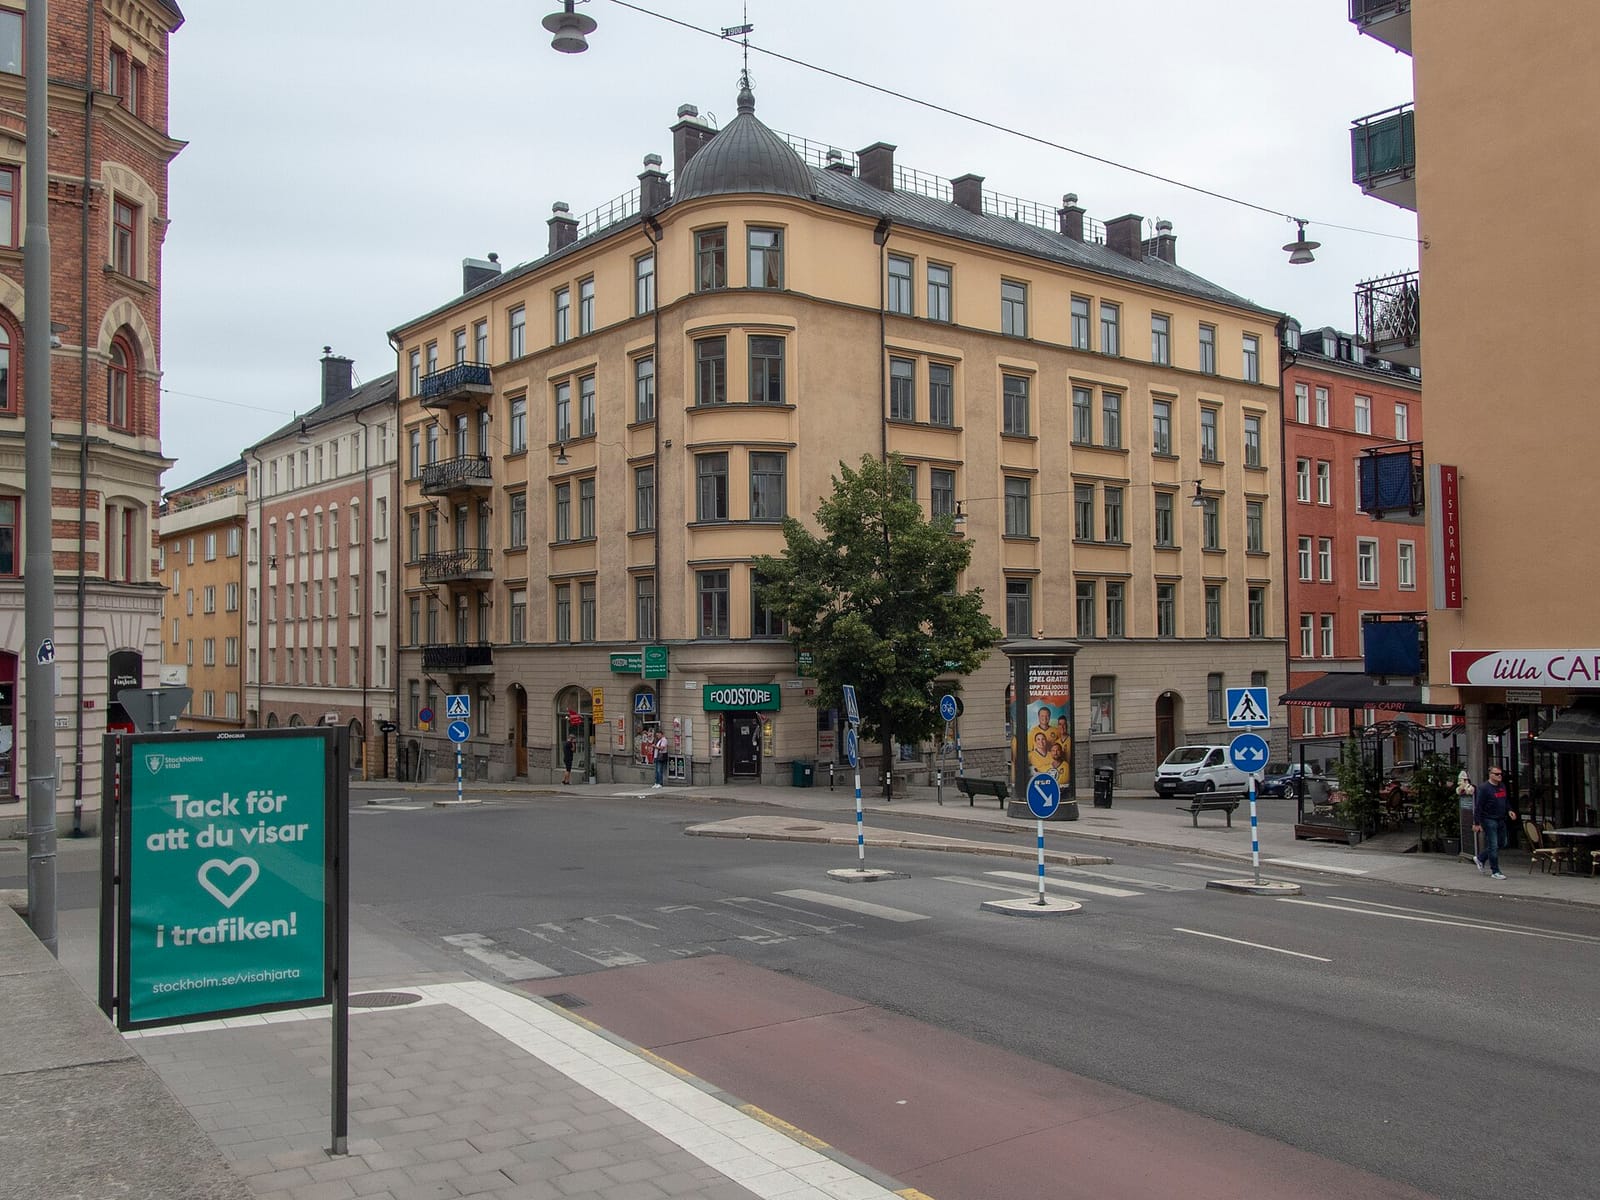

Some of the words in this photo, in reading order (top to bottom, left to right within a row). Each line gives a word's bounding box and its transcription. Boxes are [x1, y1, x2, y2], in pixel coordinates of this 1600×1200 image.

[1447, 473, 1456, 601] RISTORANTE
[1493, 658, 1542, 680] lilla
[710, 688, 771, 705] FOODSTORE
[1378, 702, 1406, 710] CAPRI
[165, 755, 204, 763] Stockholms
[170, 792, 240, 819] Tack
[245, 790, 288, 815] för
[146, 828, 189, 852] att
[196, 823, 233, 849] du
[240, 820, 309, 845] visar
[156, 925, 164, 948] i
[172, 911, 298, 946] trafiken!
[152, 967, 300, 994] stockholm.se/visahjarta
